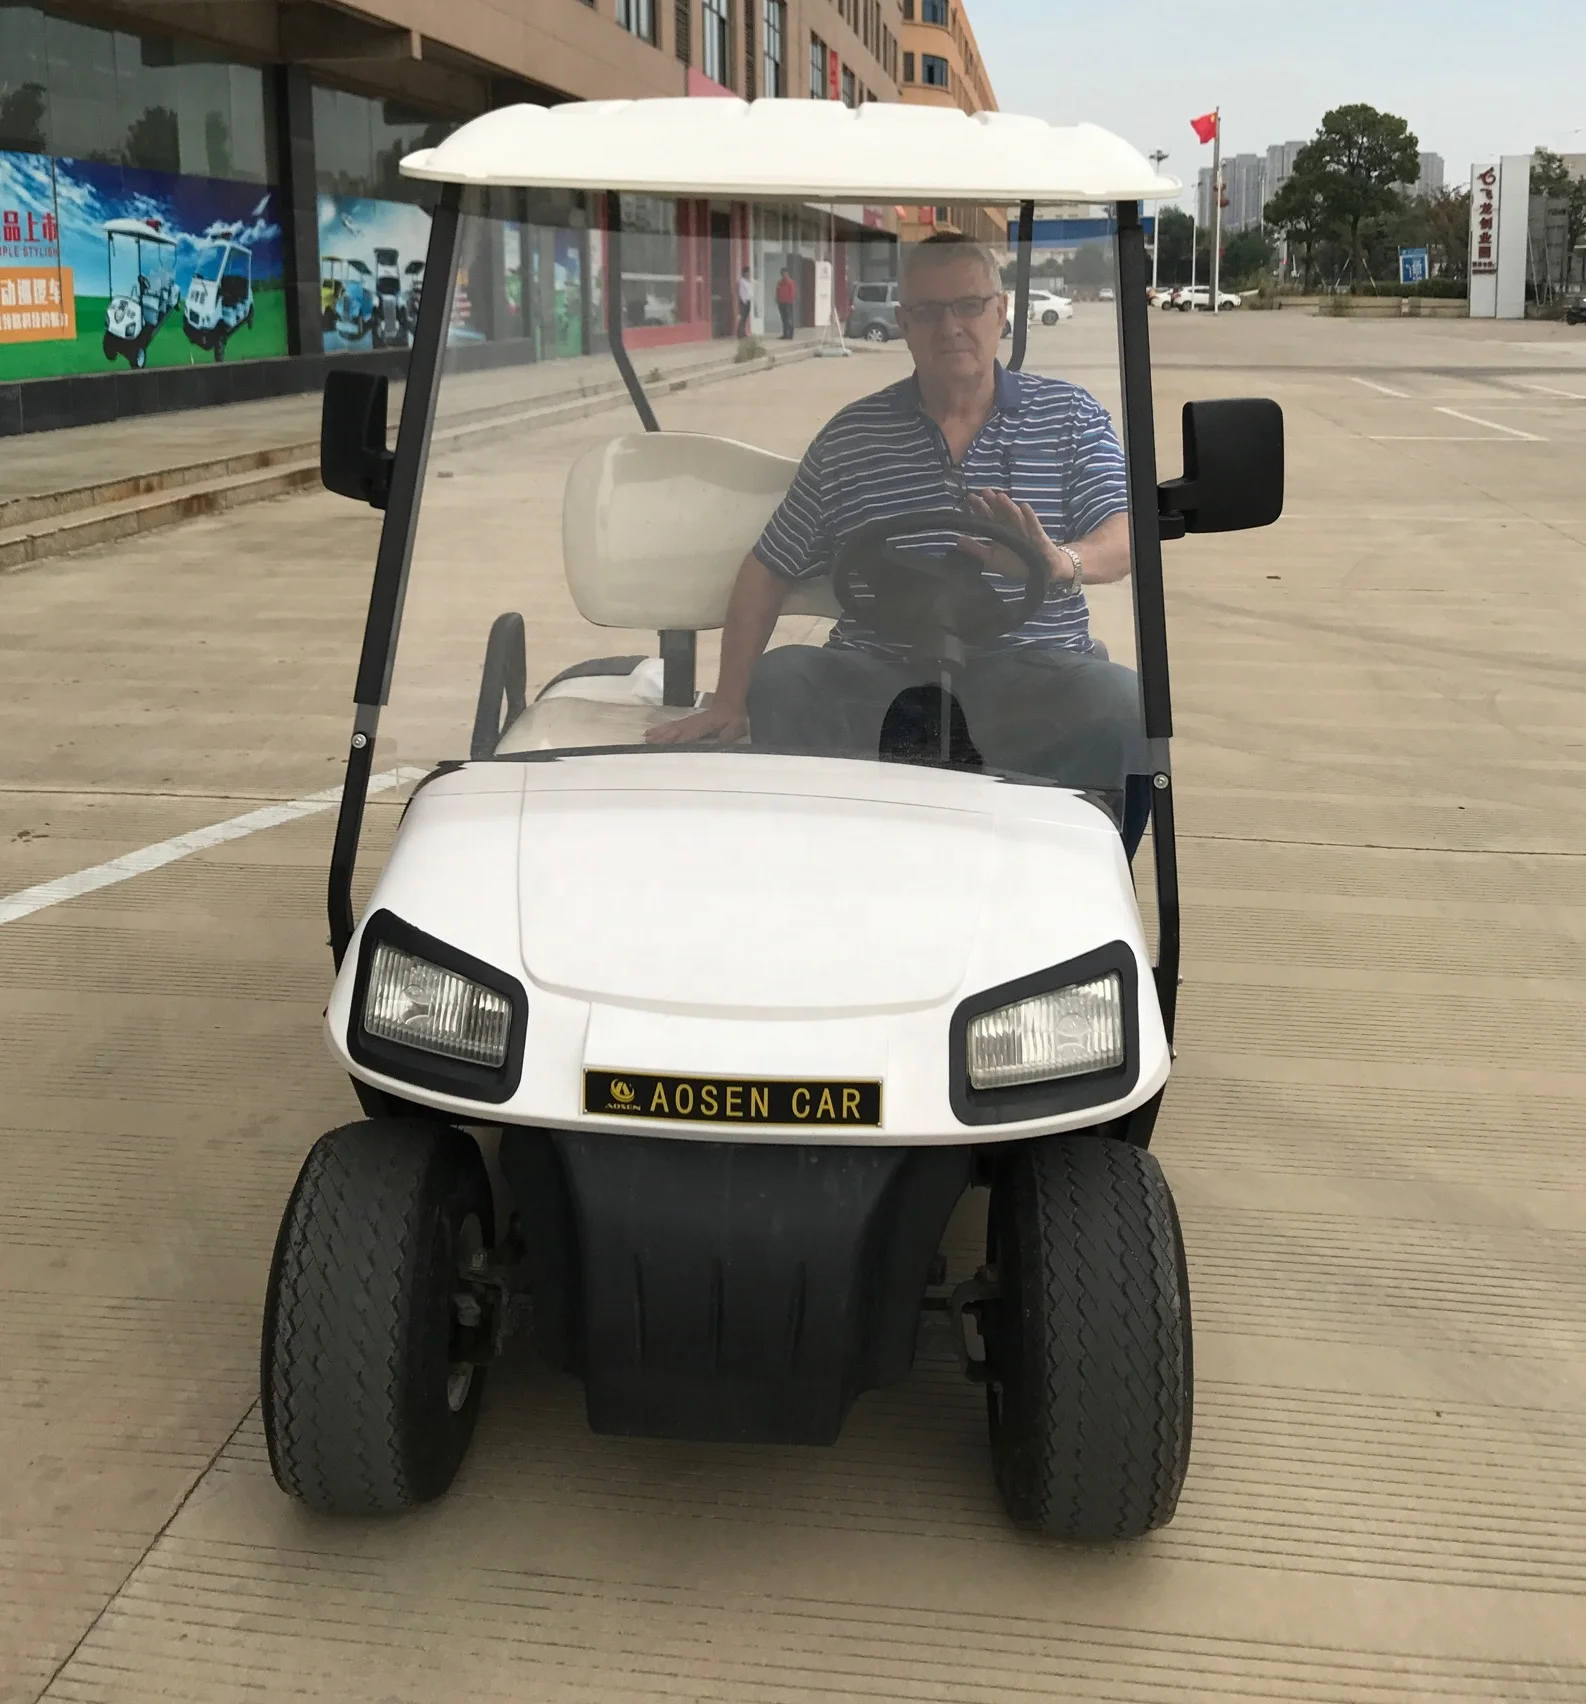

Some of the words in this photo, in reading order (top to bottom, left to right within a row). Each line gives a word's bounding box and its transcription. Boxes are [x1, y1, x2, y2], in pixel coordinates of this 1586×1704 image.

[0, 246, 19, 258] PLE
[650, 1082, 769, 1118] AOSEN
[791, 1087, 861, 1119] CAR
